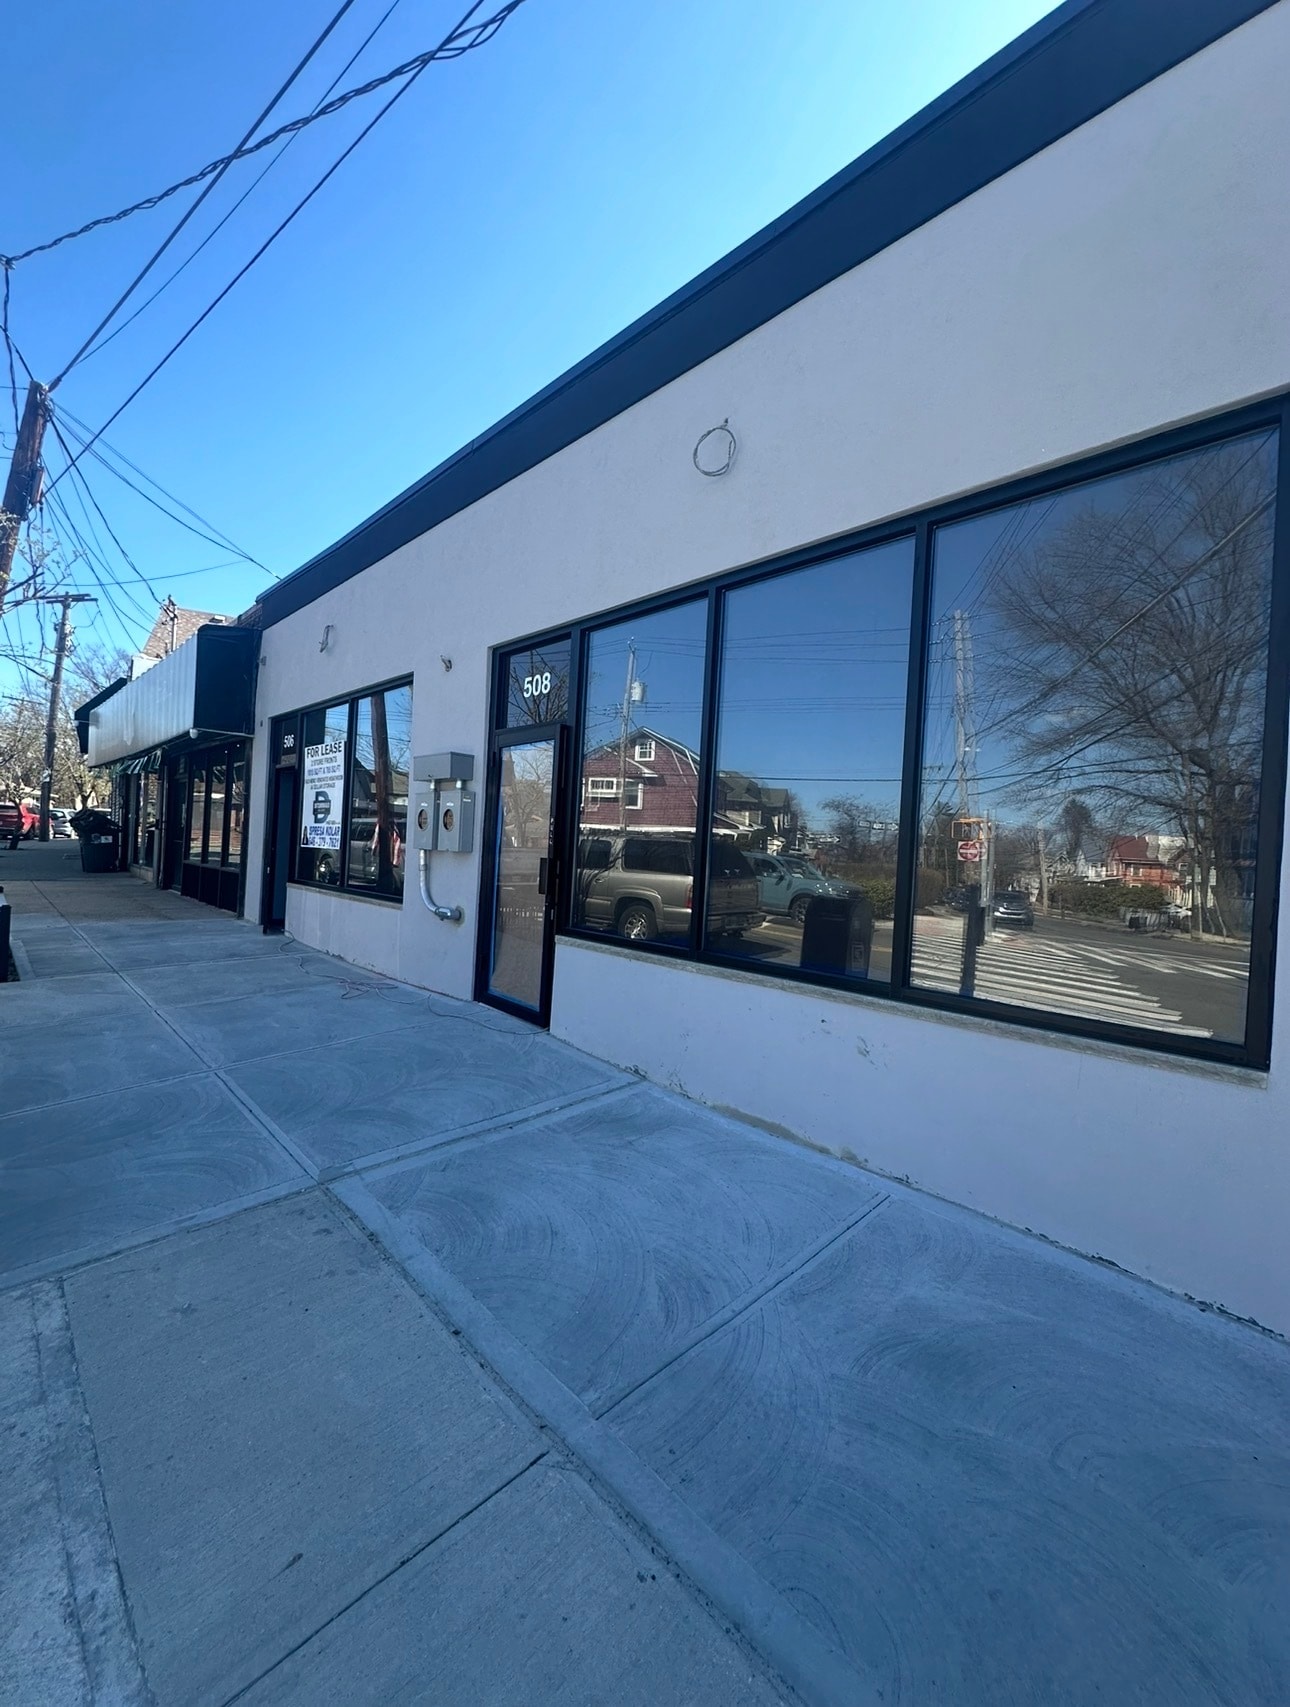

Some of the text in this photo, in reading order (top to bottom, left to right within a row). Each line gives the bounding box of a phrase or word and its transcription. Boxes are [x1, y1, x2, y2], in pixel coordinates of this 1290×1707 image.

[523, 672, 551, 698] 508
[283, 734, 295, 748] 506
[307, 741, 342, 759] FOR LEASE
